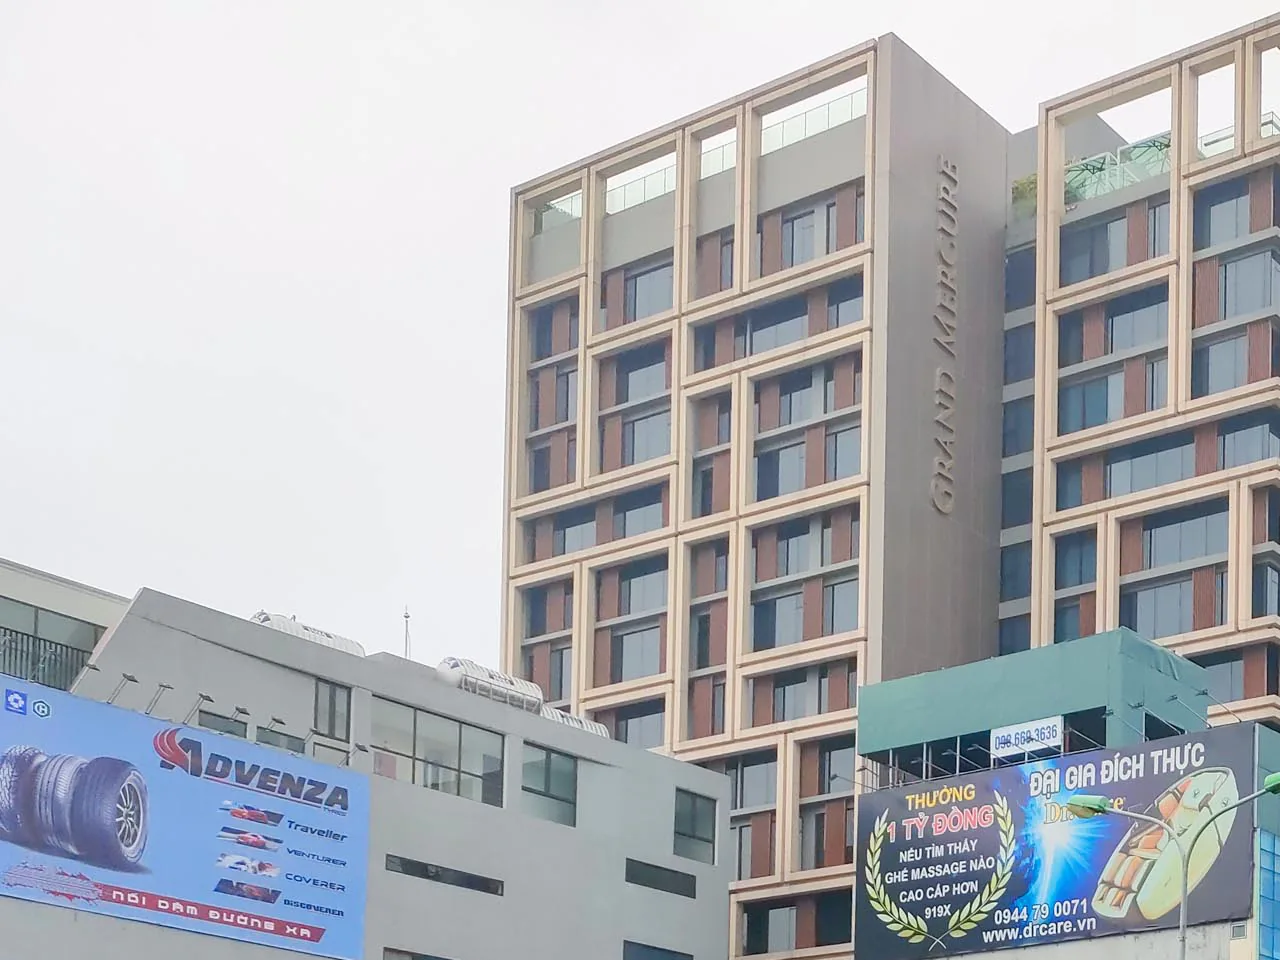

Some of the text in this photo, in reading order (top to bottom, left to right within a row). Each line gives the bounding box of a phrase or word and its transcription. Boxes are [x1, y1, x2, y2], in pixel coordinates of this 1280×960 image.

[1029, 742, 1205, 800] ĐẠI GIA ĐÍCH THỰC
[288, 820, 348, 841] Traveller
[887, 805, 995, 843] 1 TỶ ĐỒNG
[286, 847, 347, 867] VENTURER
[925, 844, 944, 858] TÌM
[911, 861, 967, 880] MASSAGE
[970, 855, 995, 871] NÀO
[285, 873, 346, 892] COVERER
[900, 888, 924, 902] CAO
[953, 880, 979, 896] HƠN
[925, 904, 952, 919] 919X
[995, 898, 1087, 925] 0944 79 0071
[982, 917, 1097, 943] www.drcare.vn
